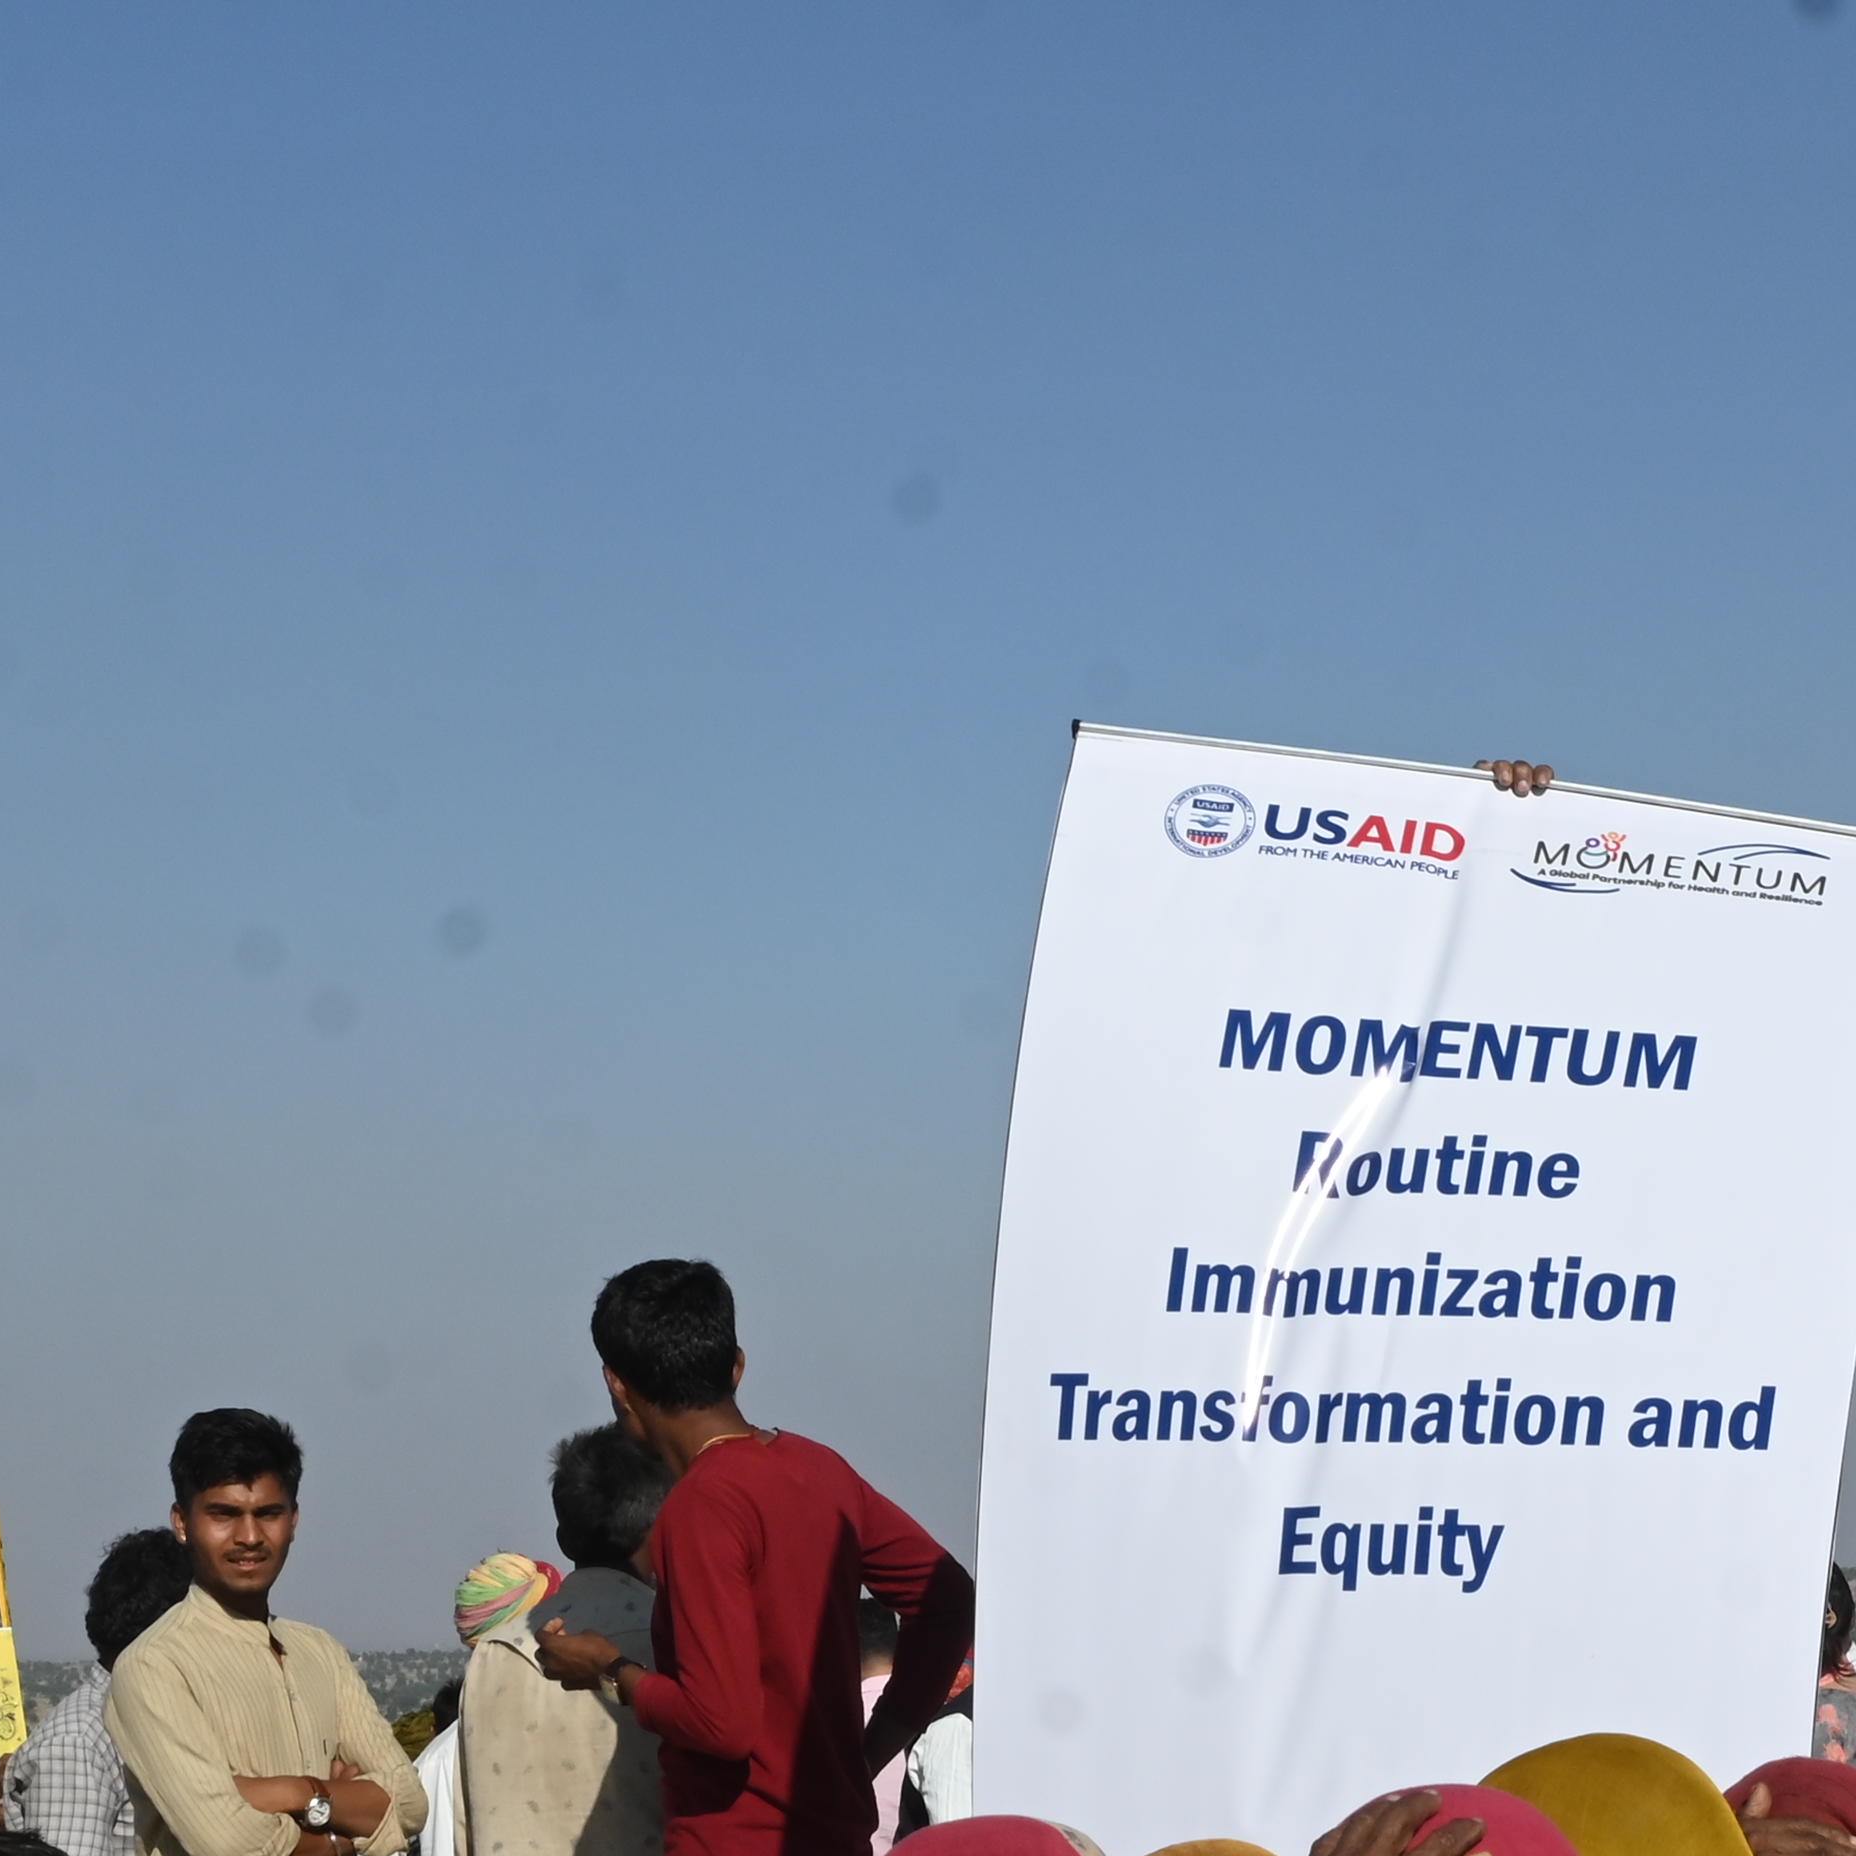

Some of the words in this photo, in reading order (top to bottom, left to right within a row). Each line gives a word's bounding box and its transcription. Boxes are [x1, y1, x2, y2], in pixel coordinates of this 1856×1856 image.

[1196, 801, 1230, 811] USAID
[1202, 786, 1230, 794] STATES
[1231, 790, 1253, 813] AGENCY
[1264, 804, 1466, 862] USAID
[1258, 845, 1298, 858] FROM
[1300, 848, 1329, 861] THE
[1331, 852, 1406, 870] AMERICAN
[1410, 860, 1461, 880] PEOPLE
[1533, 838, 1827, 896] MOMENTUM
[1537, 867, 1547, 877] A
[1549, 868, 1590, 880] Global
[1592, 873, 1666, 889] Partnership
[1667, 881, 1686, 892] for
[1688, 883, 1728, 896] Health
[1732, 889, 1757, 899] and
[1759, 892, 1824, 907] Resilience
[1219, 1009, 1698, 1091] MOMENTUM
[1293, 1131, 1580, 1199] Routine
[1166, 1247, 1677, 1322] Immunization
[1050, 1373, 1604, 1446] Transformation
[1628, 1385, 1776, 1450] and
[1278, 1506, 1504, 1593] Equity
